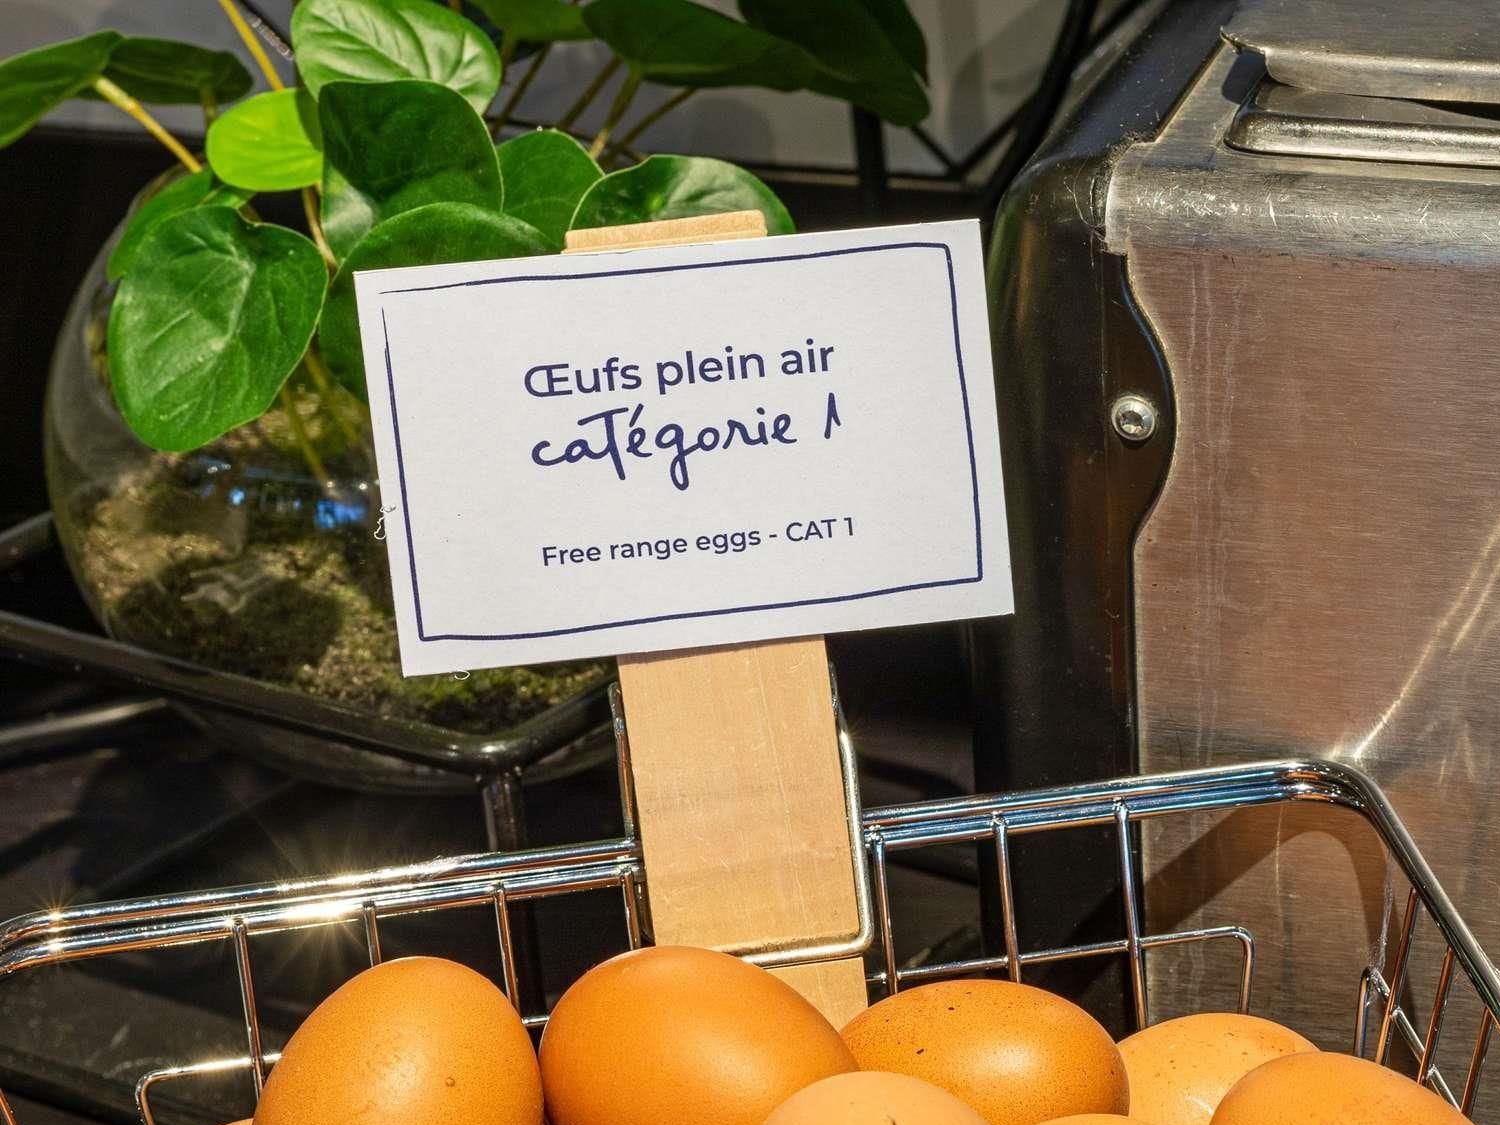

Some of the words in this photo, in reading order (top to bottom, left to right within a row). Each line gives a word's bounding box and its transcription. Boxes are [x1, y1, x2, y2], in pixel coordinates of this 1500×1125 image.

[524, 356, 643, 398] Œufs
[655, 345, 766, 396] plein
[780, 338, 835, 376] air
[531, 402, 798, 492] catégorie
[823, 392, 842, 440] 1
[541, 545, 602, 567] Free
[609, 537, 688, 561] range
[695, 530, 762, 555] eggs
[785, 518, 838, 542] CAT
[843, 516, 854, 537] 1
